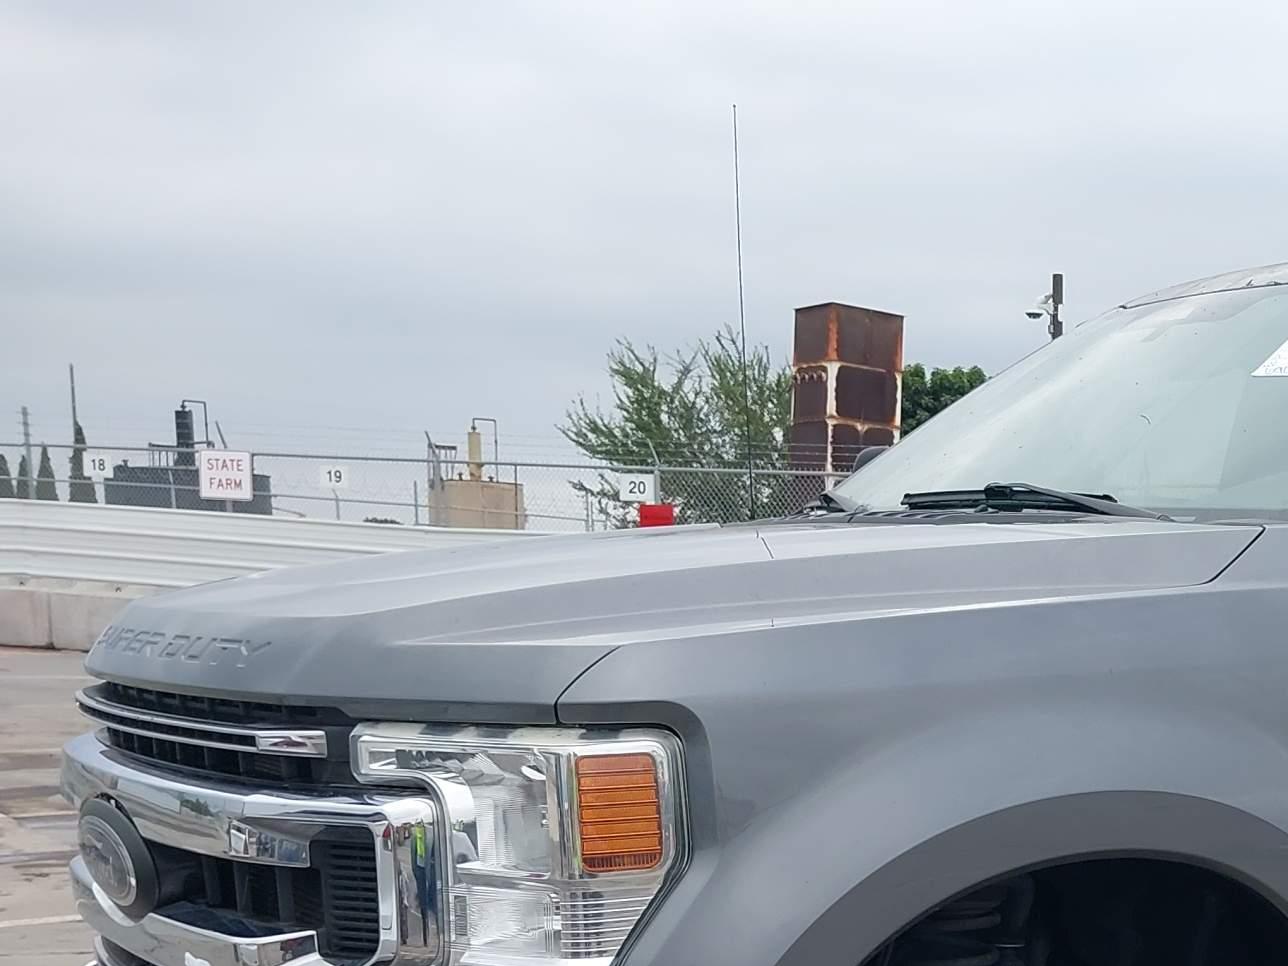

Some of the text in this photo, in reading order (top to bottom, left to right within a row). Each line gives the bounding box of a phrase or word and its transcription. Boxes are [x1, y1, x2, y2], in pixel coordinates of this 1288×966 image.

[91, 458, 106, 472] 18
[207, 458, 245, 472] STATE
[326, 470, 342, 483] 19
[209, 477, 243, 491] FARM
[628, 480, 646, 495] 20
